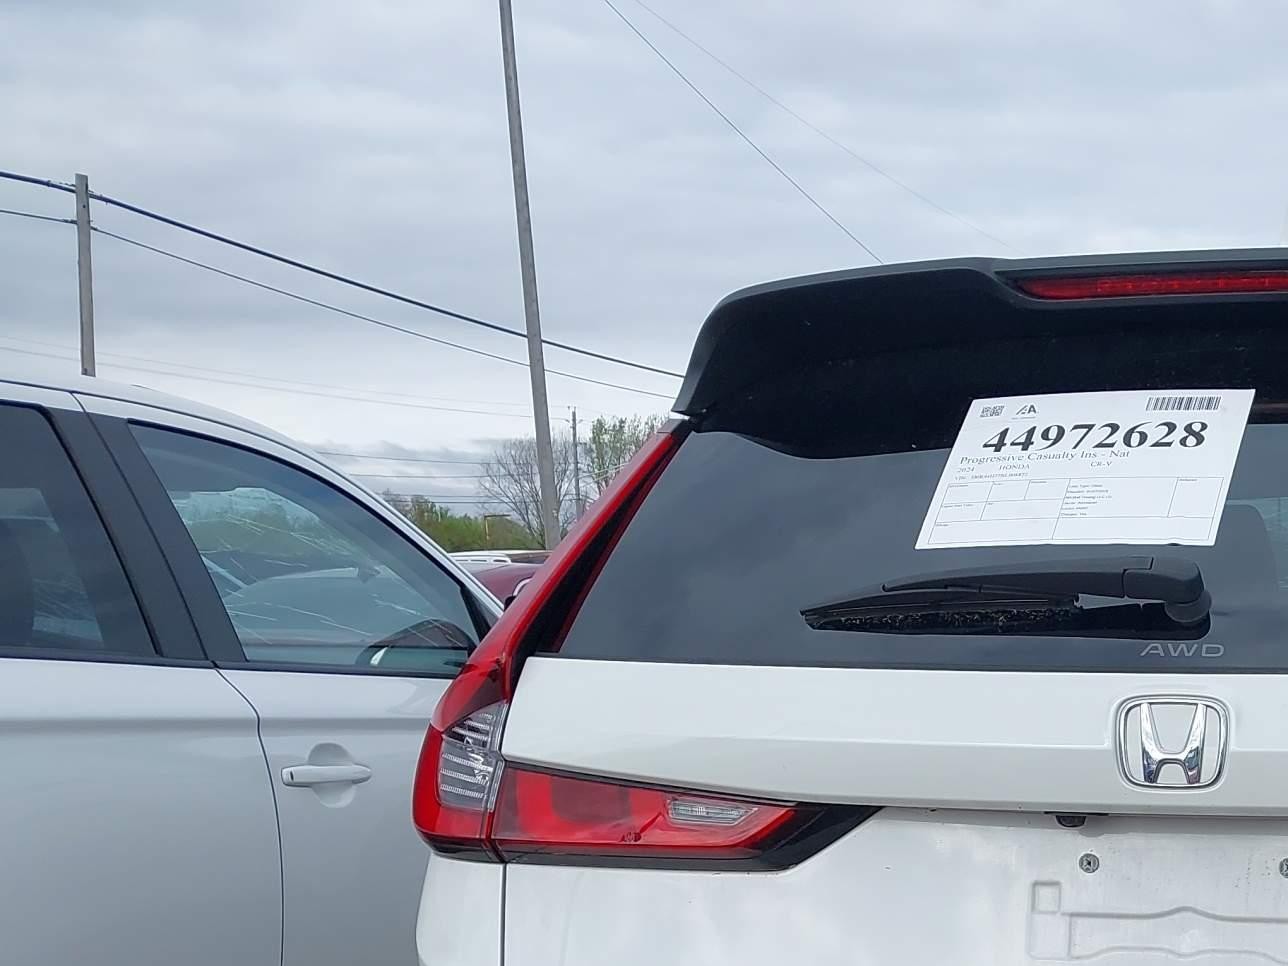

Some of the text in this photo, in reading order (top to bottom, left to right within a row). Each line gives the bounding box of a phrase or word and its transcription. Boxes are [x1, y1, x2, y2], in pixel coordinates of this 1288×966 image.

[983, 420, 1209, 453] 44972628
[960, 455, 1025, 465] Progressive
[1027, 451, 1077, 461] Casualty
[1081, 450, 1097, 458] Ins
[1109, 449, 1131, 459] Nat
[999, 463, 1030, 471] HONDA
[1140, 643, 1224, 658] AWD
